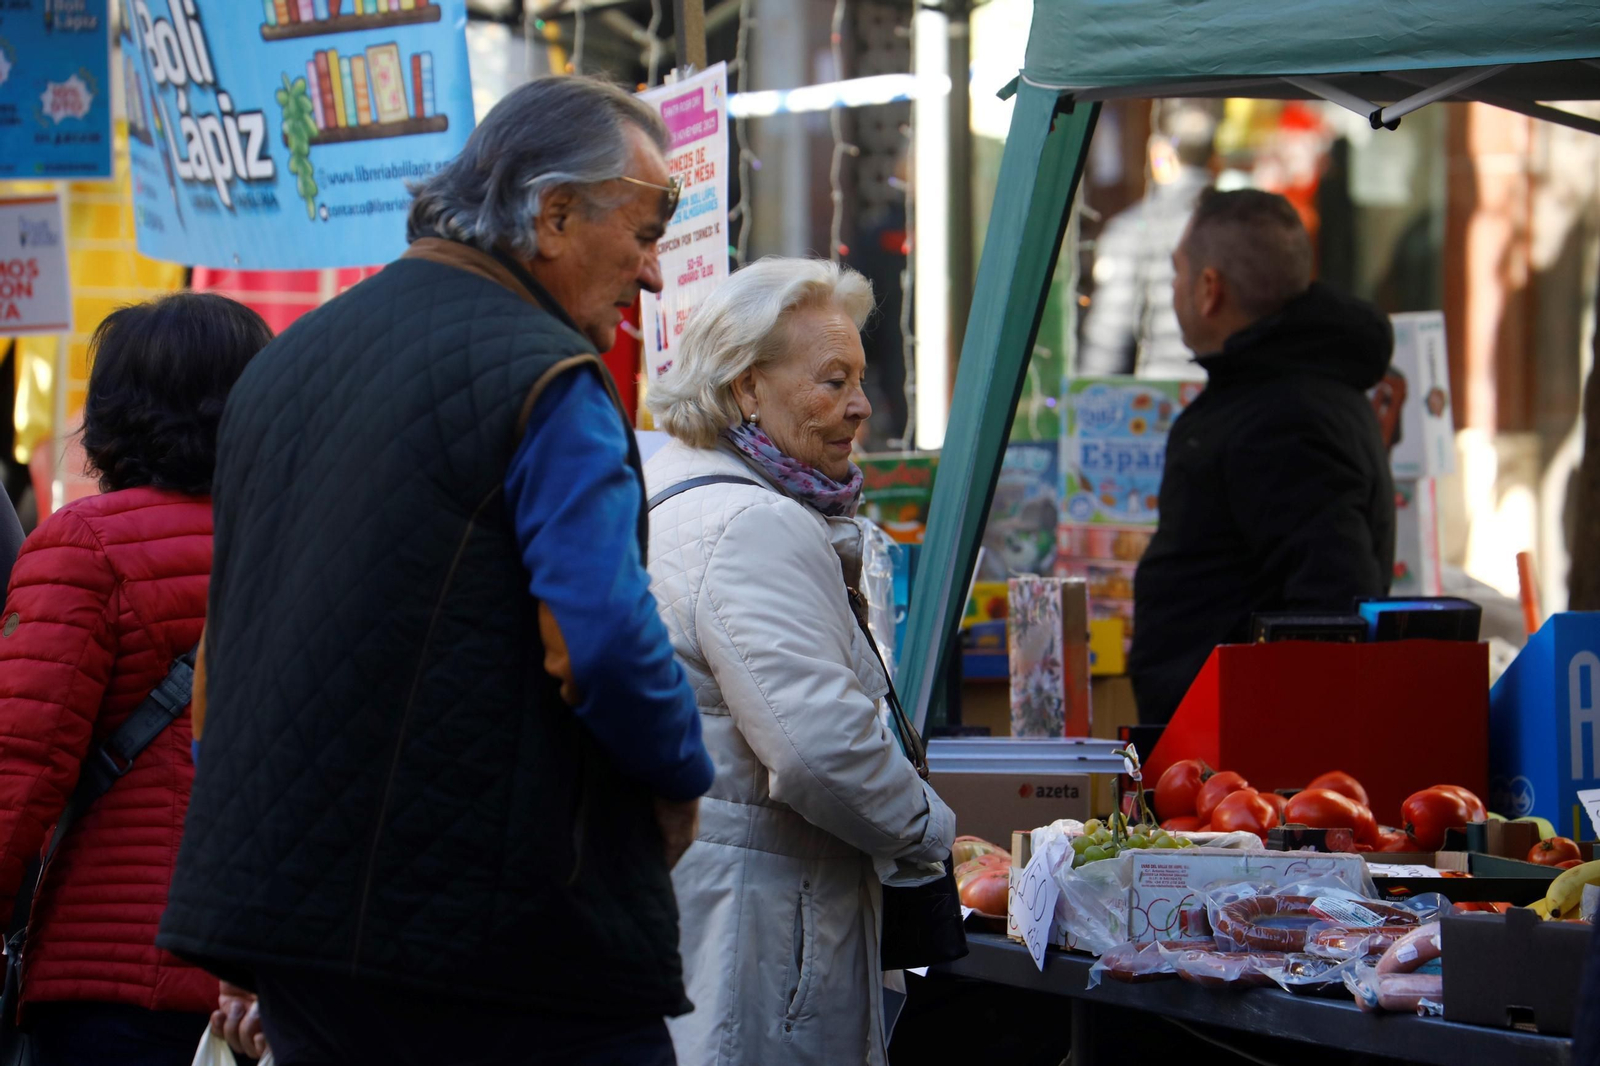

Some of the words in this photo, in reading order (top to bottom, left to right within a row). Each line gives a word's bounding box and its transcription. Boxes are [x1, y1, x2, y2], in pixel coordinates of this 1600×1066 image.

[134, 0, 215, 86] Boli
[669, 152, 693, 174] RNEOS
[695, 146, 706, 165] DE
[695, 162, 715, 183] MESA
[657, 236, 680, 254] CRIPCIÓN
[1035, 784, 1079, 798] azeta
